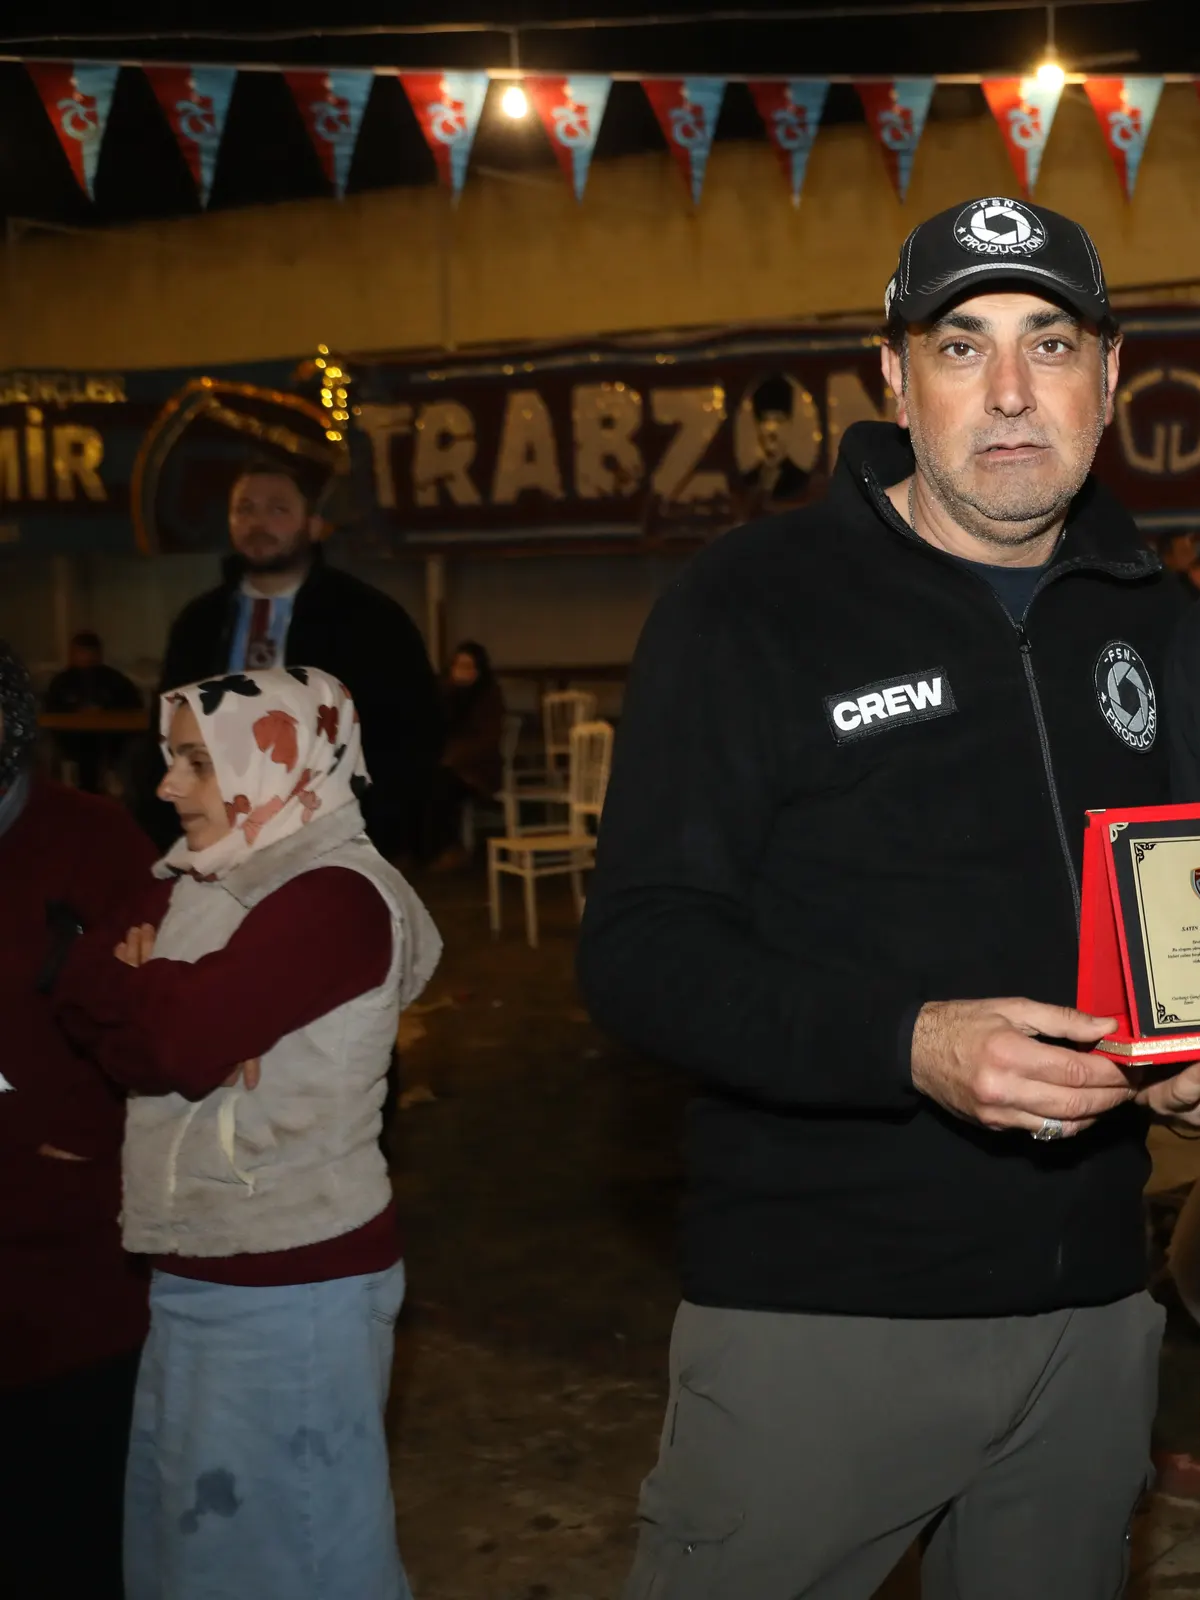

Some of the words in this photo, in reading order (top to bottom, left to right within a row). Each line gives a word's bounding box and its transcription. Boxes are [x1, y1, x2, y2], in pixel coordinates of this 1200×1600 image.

[960, 234, 1045, 254] PRODUCTION
[833, 677, 941, 731] CREW
[1106, 705, 1156, 747] PRODUCTION
